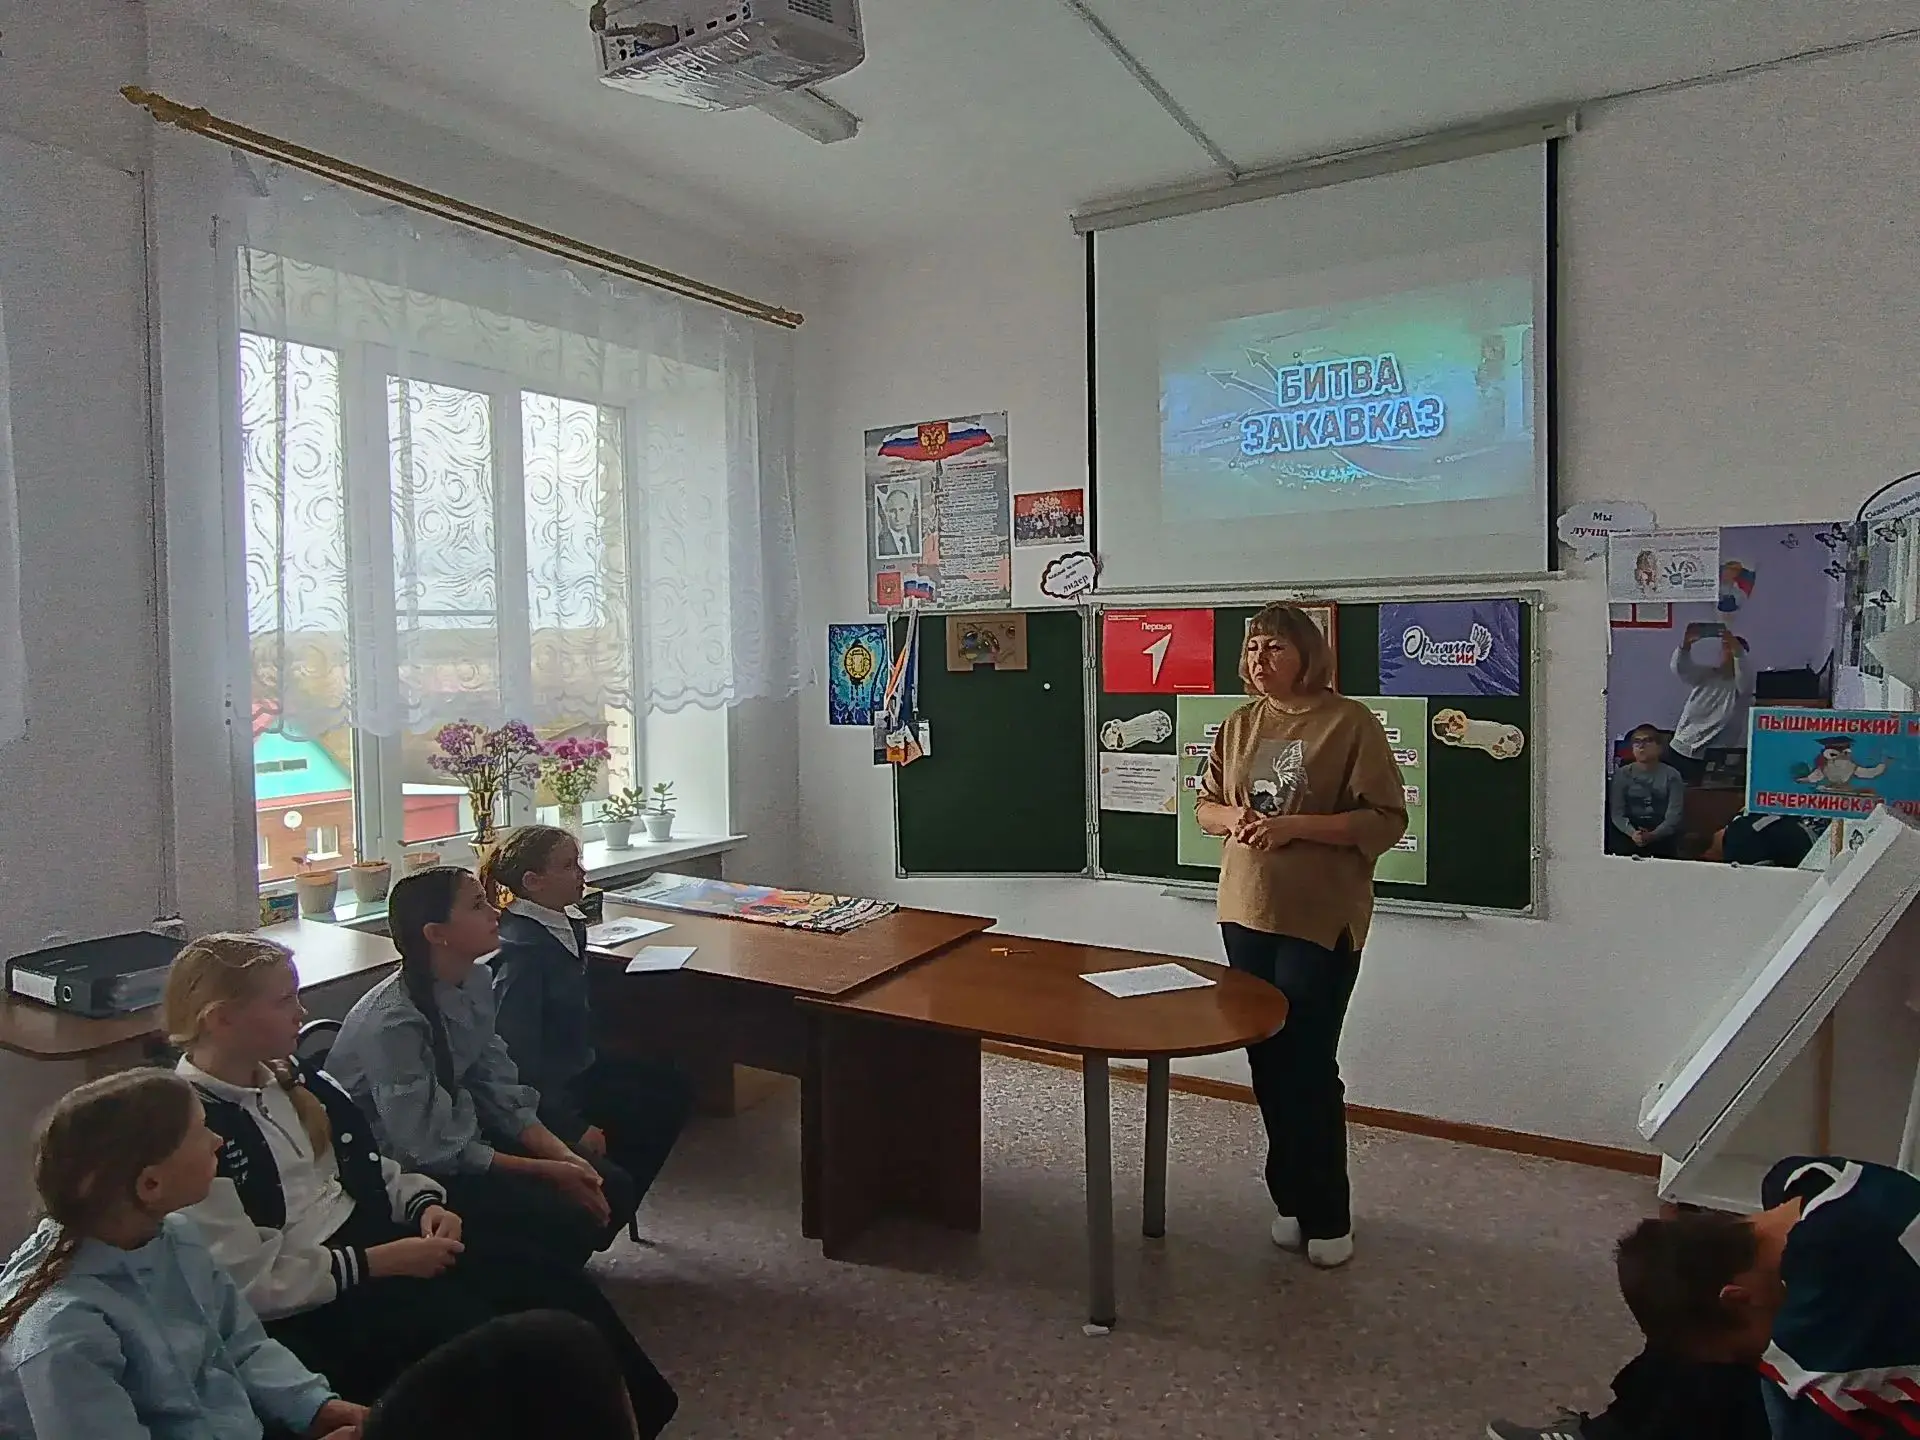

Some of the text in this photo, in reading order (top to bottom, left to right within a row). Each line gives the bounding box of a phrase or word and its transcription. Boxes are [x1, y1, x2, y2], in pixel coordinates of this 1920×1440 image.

[1278, 354, 1402, 407] БИТВА
[1241, 395, 1445, 454] ЗА КАВКАЗ
[1592, 511, 1612, 521] Мы
[1063, 575, 1088, 593] лидер
[1404, 627, 1475, 660] Орлята
[1758, 713, 1900, 735] ПЫШМИНСКИЙ
